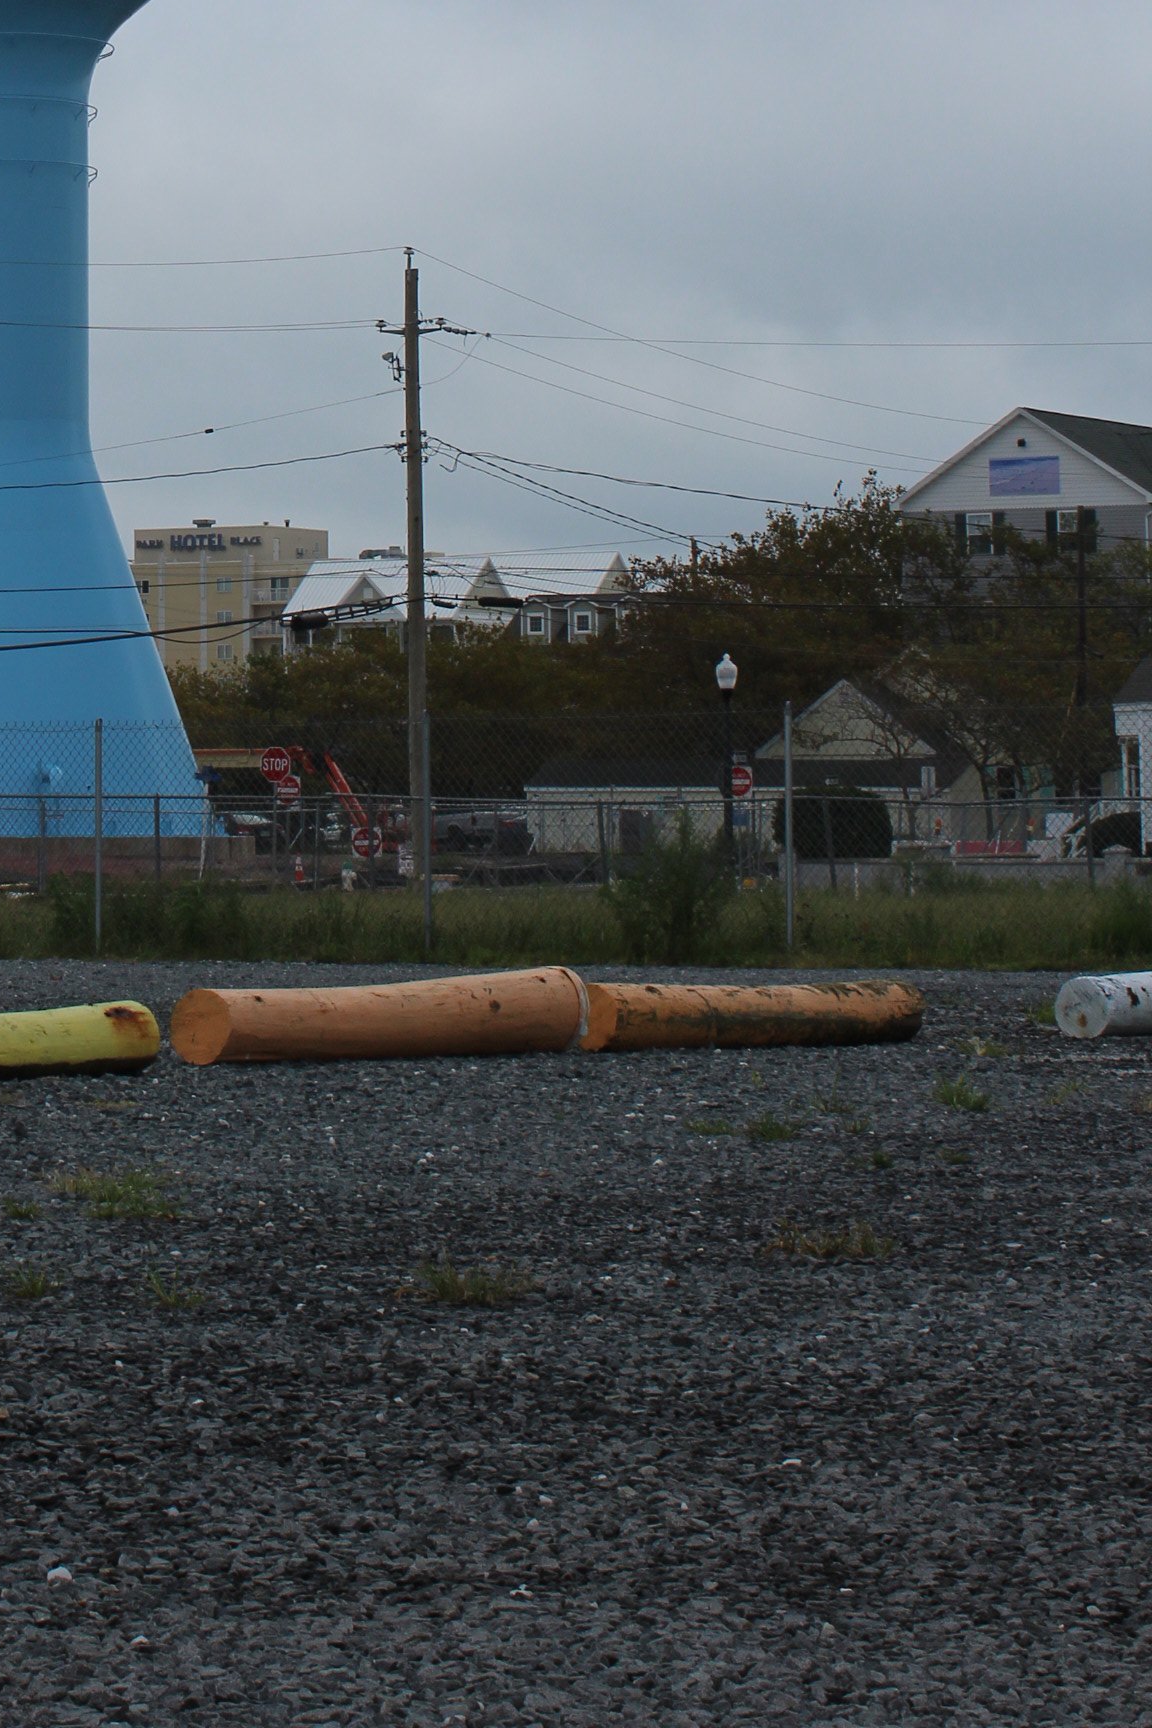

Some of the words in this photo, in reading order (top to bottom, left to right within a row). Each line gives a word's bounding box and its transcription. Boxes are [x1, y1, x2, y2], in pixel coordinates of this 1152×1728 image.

[136, 539, 164, 549] PARK
[170, 534, 226, 551] HOTEL
[262, 757, 288, 771] STOP
